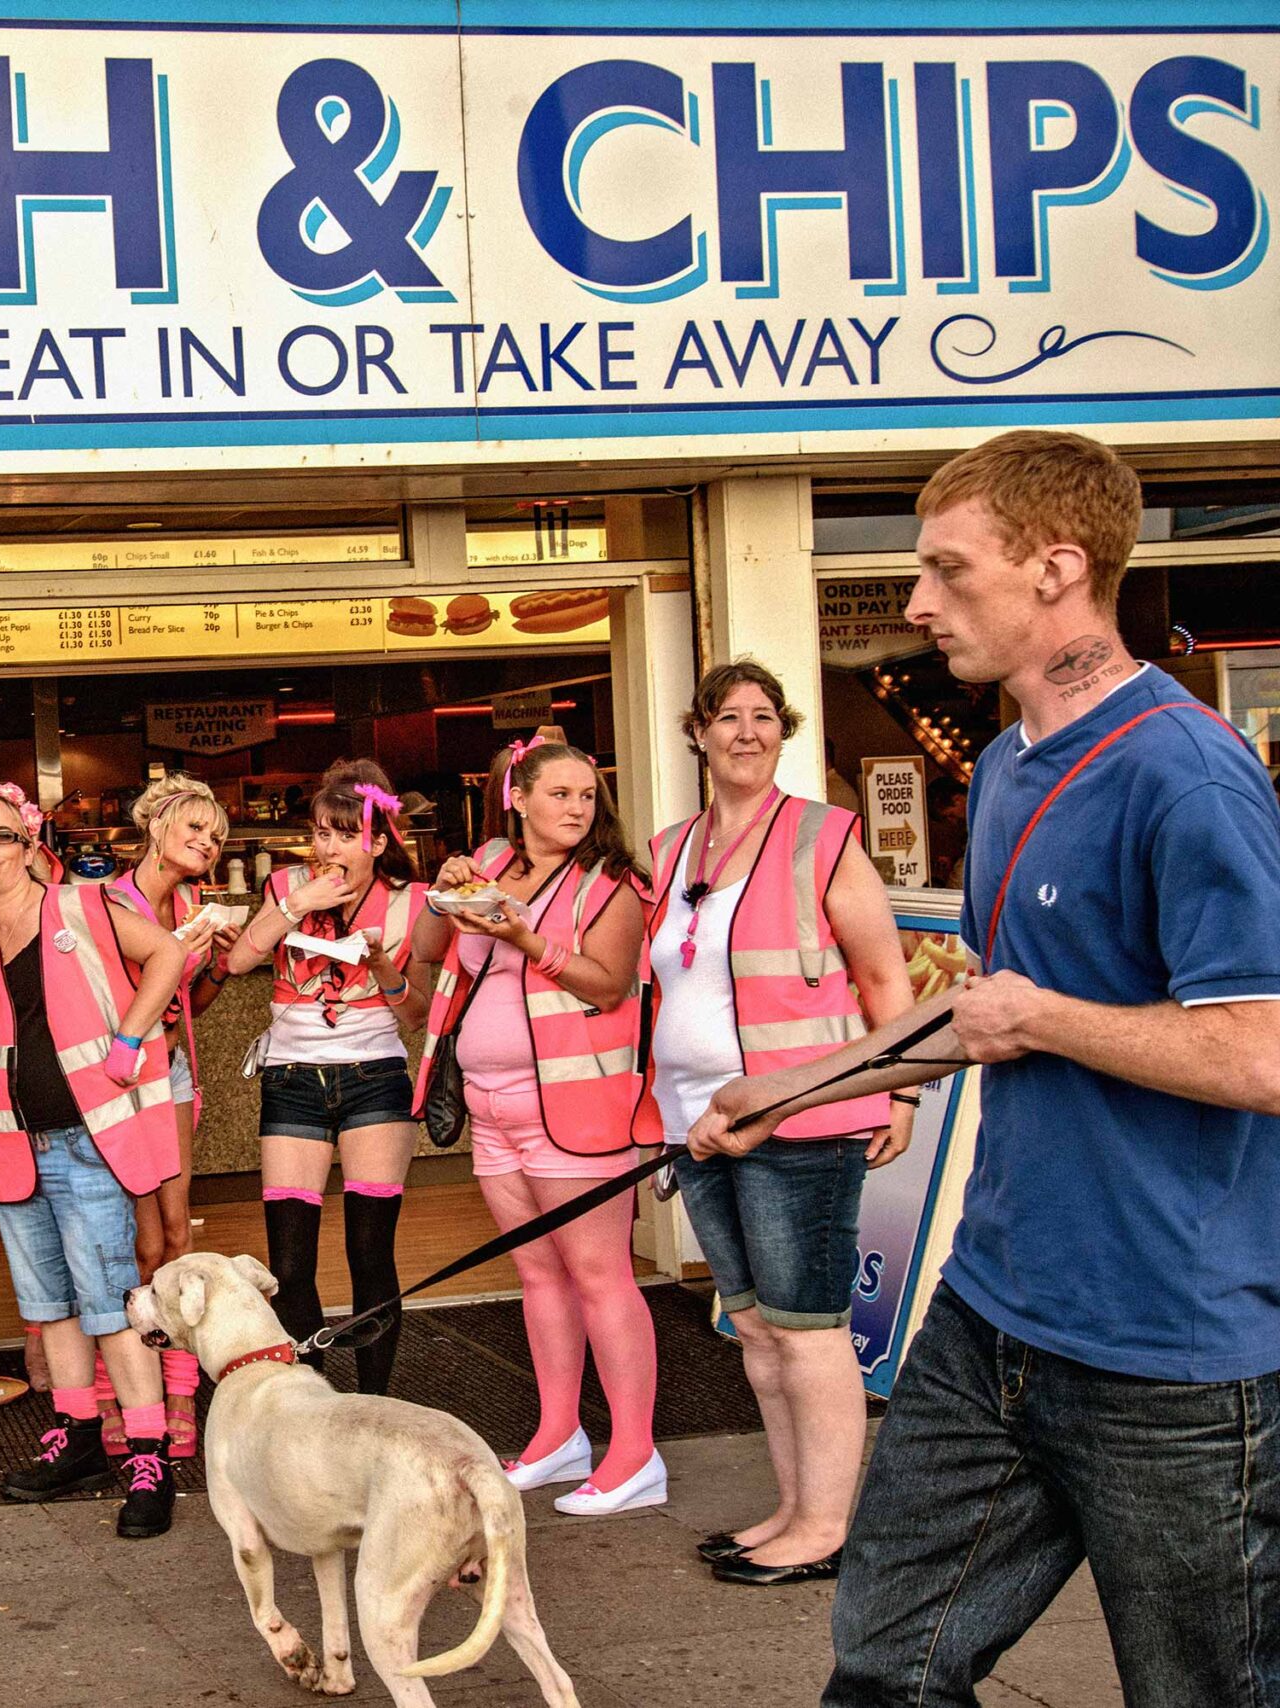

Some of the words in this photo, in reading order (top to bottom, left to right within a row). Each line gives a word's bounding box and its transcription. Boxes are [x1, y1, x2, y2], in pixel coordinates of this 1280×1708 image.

[257, 57, 457, 304] &
[518, 55, 1271, 303] CHIPS
[159, 326, 246, 398] IN
[278, 324, 408, 396] OR
[430, 321, 638, 393] TAKE
[665, 317, 900, 390] AWAY
[569, 540, 588, 549] Dogs
[92, 553, 108, 563] 60p
[126, 552, 147, 561] Chips
[150, 551, 170, 559] Small
[194, 550, 217, 558] £1.60
[277, 548, 299, 557] Chips
[347, 546, 369, 554] £4.59
[824, 583, 887, 598] ORDER
[59, 611, 82, 619] £1.30
[88, 610, 111, 618] £1.50
[255, 609, 266, 617] Pie
[269, 609, 274, 617] &
[277, 609, 298, 618] Chips
[350, 606, 372, 614] £3.30
[858, 601, 891, 615] PAY
[128, 613, 151, 623] Curry
[204, 611, 220, 620] 70p
[10, 623, 31, 633] Pepsi
[59, 621, 82, 629] £1.30
[88, 620, 111, 628] £1.50
[128, 626, 150, 634] Bread
[153, 625, 165, 633] Per
[168, 625, 185, 633] Slice
[205, 624, 220, 632] 20p
[256, 622, 280, 631] Burger
[284, 621, 289, 629] &
[291, 620, 313, 629] Chips
[350, 618, 373, 626] £3.39
[854, 623, 914, 635] SEATING
[60, 631, 83, 639] £1.30
[89, 630, 112, 638] £1.50
[60, 640, 83, 649] £1.30
[89, 640, 112, 648] £1.50
[836, 639, 869, 651] WAY
[1059, 675, 1099, 702] TURBO
[1101, 664, 1123, 677] TED
[153, 704, 266, 719] RESTAURANT
[495, 706, 549, 719] MACHINE
[175, 720, 246, 733] SEATING
[189, 734, 234, 747] AREA
[876, 772, 914, 786] PLEASE
[877, 787, 914, 801] ORDER
[882, 802, 911, 815] FOOD
[879, 831, 912, 847] HERE
[899, 862, 918, 876] EAT
